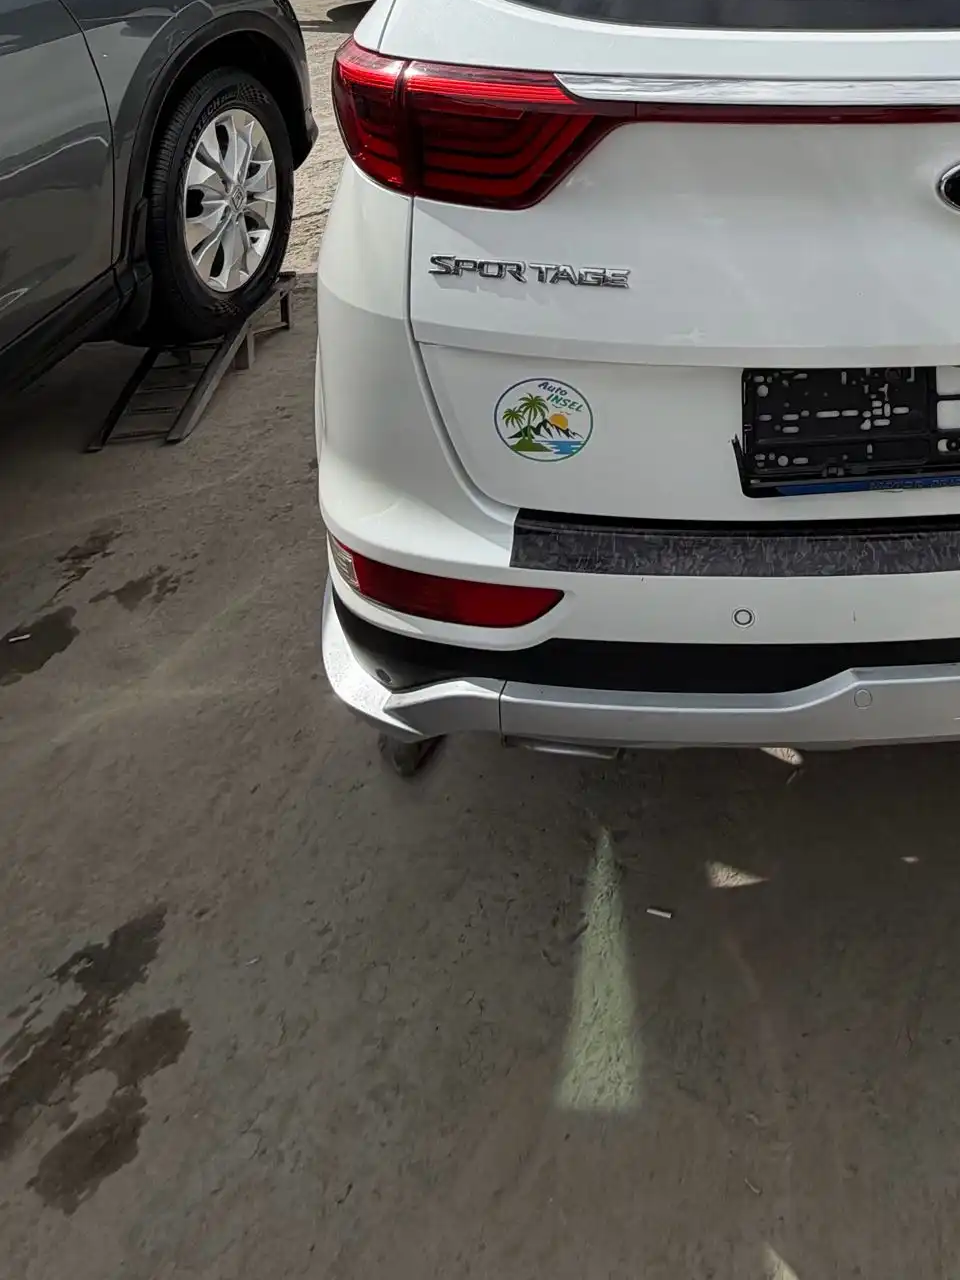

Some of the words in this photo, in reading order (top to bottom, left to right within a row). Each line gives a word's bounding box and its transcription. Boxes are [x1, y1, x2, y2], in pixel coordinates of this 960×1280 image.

[428, 253, 631, 289] SPORTAGE
[538, 381, 568, 397] Auto
[546, 393, 585, 413] INSEL
